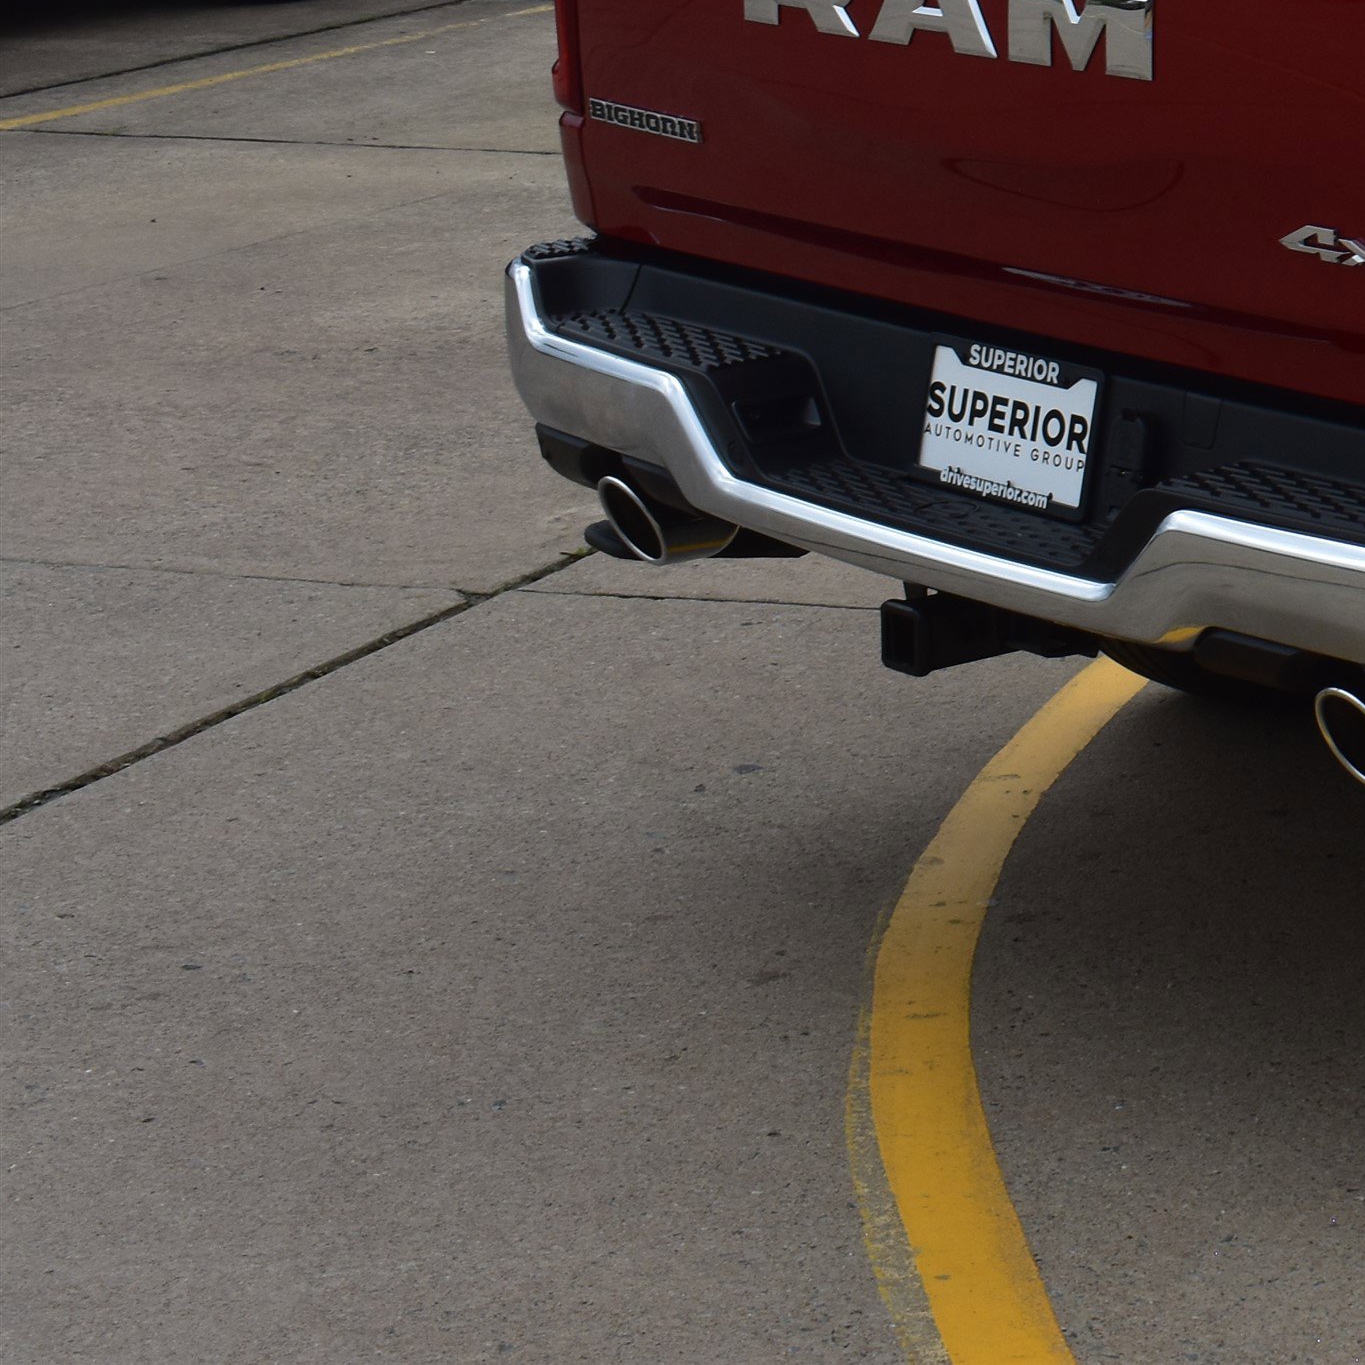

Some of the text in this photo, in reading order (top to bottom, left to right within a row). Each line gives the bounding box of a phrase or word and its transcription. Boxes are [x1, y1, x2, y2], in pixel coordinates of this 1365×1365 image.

[588, 97, 703, 144] BIGHORN
[968, 343, 1060, 385] SUPERIOR
[926, 380, 1088, 455] SUPERIOR
[923, 421, 1085, 474] AUTOMOTIVE GROUP
[939, 466, 1049, 509] drivesuperior.com
